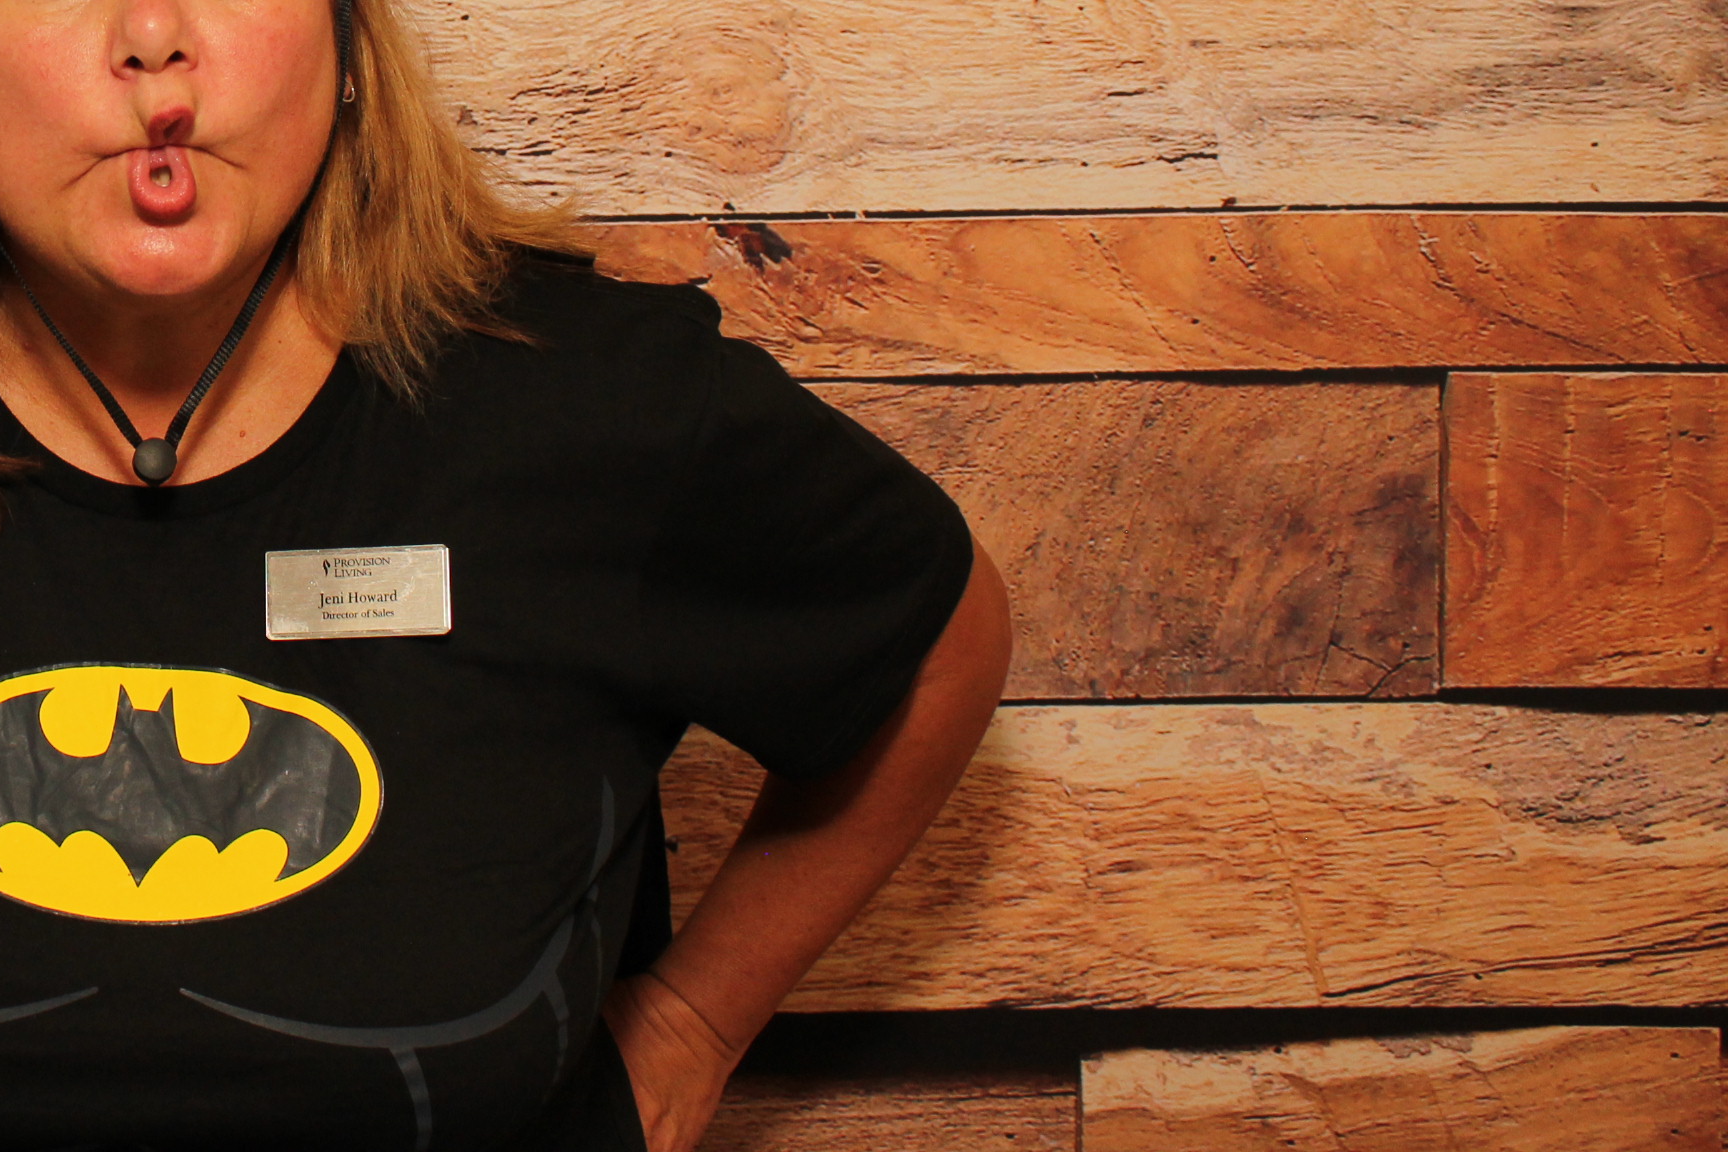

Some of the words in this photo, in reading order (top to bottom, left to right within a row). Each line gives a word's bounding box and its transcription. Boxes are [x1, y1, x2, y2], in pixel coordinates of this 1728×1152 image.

[333, 557, 390, 567] PROVISION
[334, 568, 372, 578] LIVING
[317, 591, 344, 609] Jeni
[348, 589, 397, 604] Howard
[321, 610, 358, 620] Director
[360, 609, 372, 619] of
[372, 608, 395, 618] Sales
